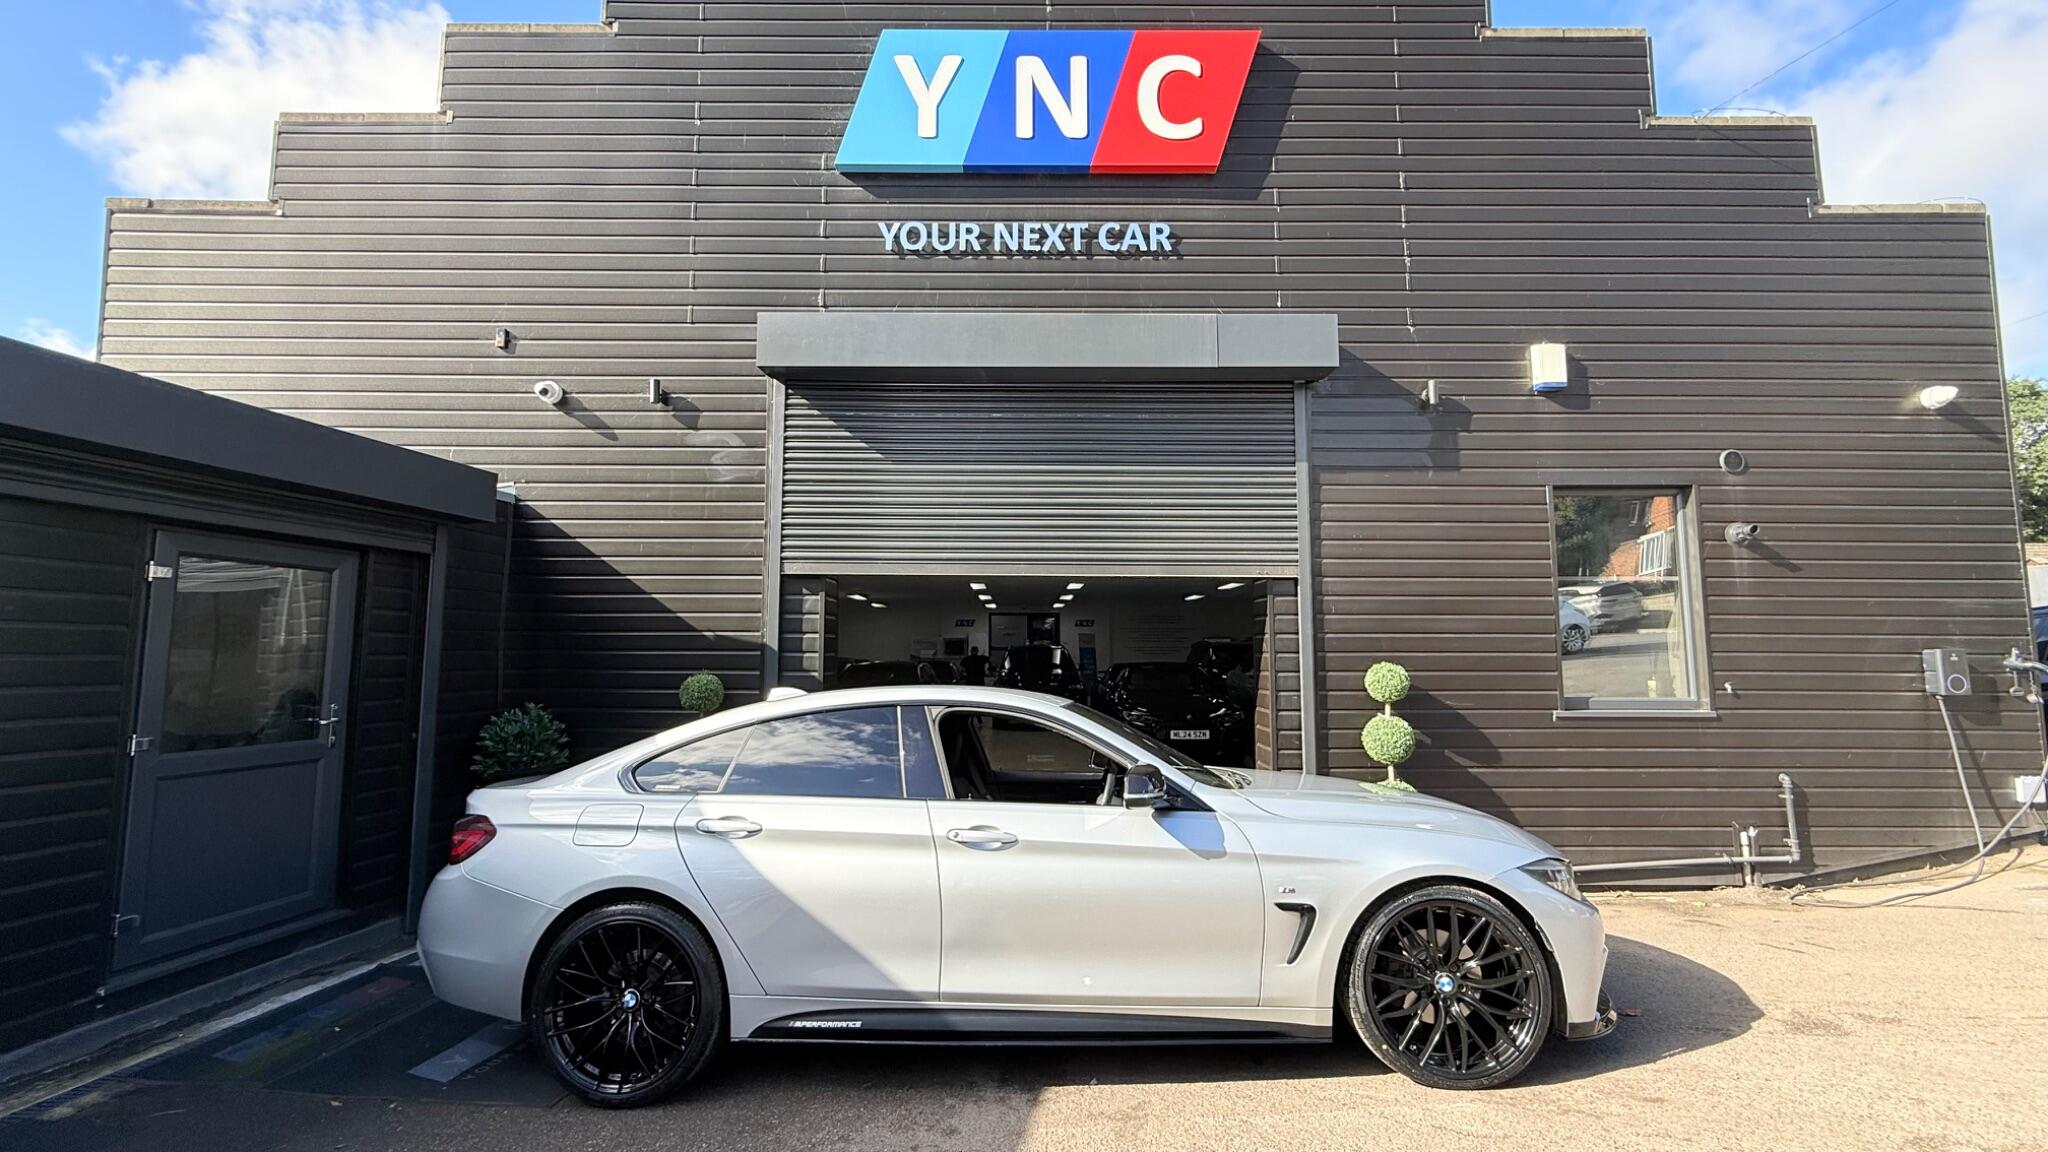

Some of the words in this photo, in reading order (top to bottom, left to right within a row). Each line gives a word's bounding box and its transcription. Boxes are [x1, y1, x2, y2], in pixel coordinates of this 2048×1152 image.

[894, 54, 1203, 140] YNC
[878, 222, 980, 252] YOUR
[993, 222, 1089, 252] NEXT
[1098, 222, 1173, 252] CAR
